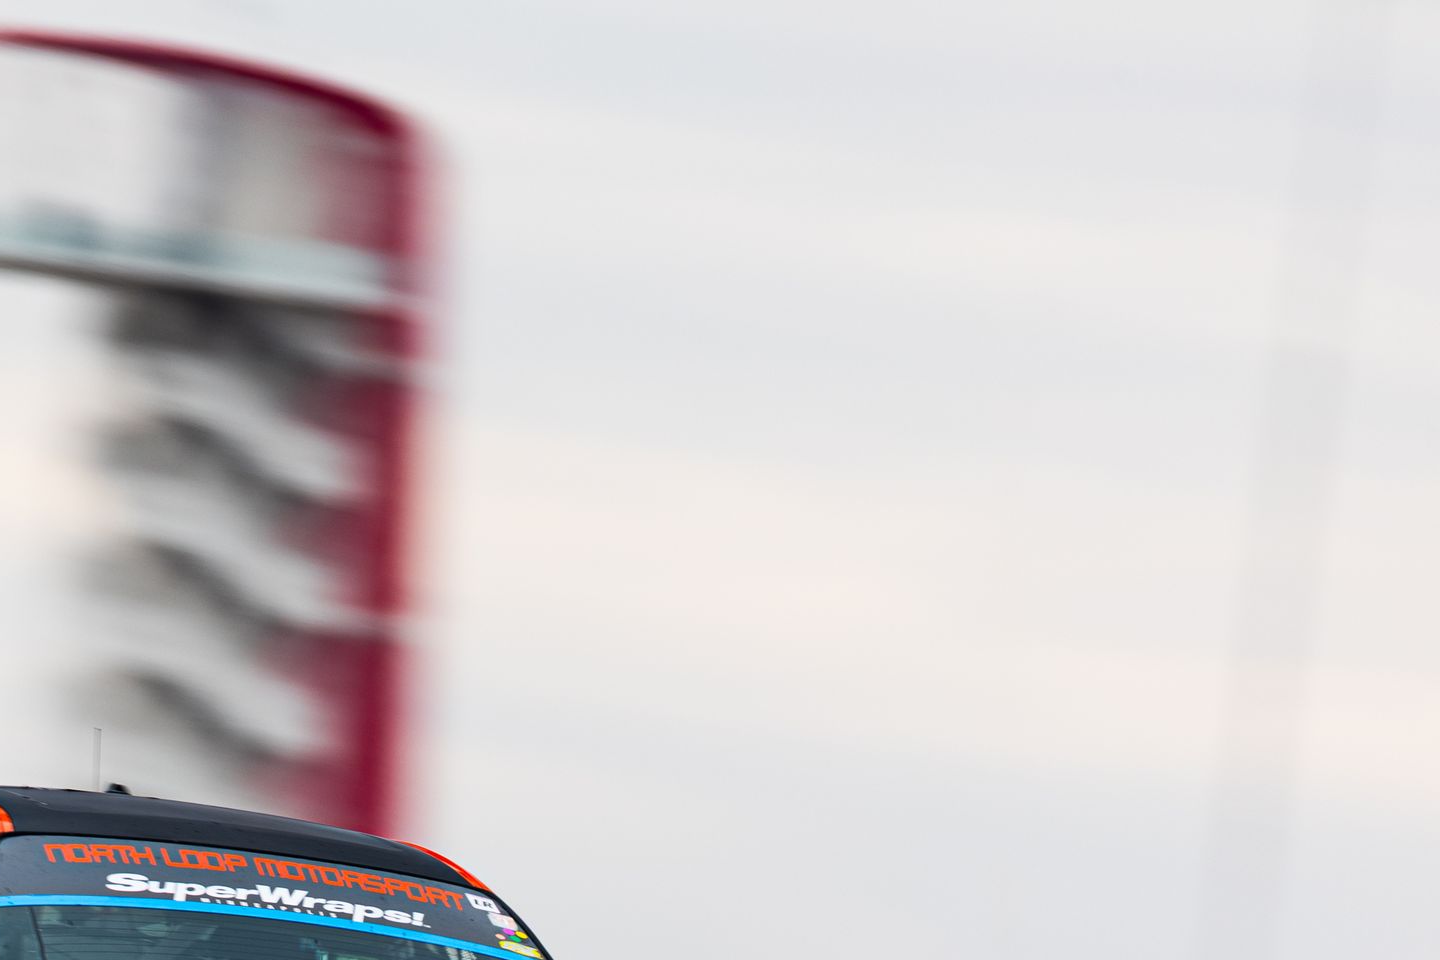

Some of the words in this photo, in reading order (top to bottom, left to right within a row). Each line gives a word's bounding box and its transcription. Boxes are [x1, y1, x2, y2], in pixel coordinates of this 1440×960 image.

[43, 843, 157, 866] NORTH
[160, 847, 248, 872] LOOP
[253, 857, 465, 911] MOTORSPORT
[105, 872, 426, 926] SuperWraps!
